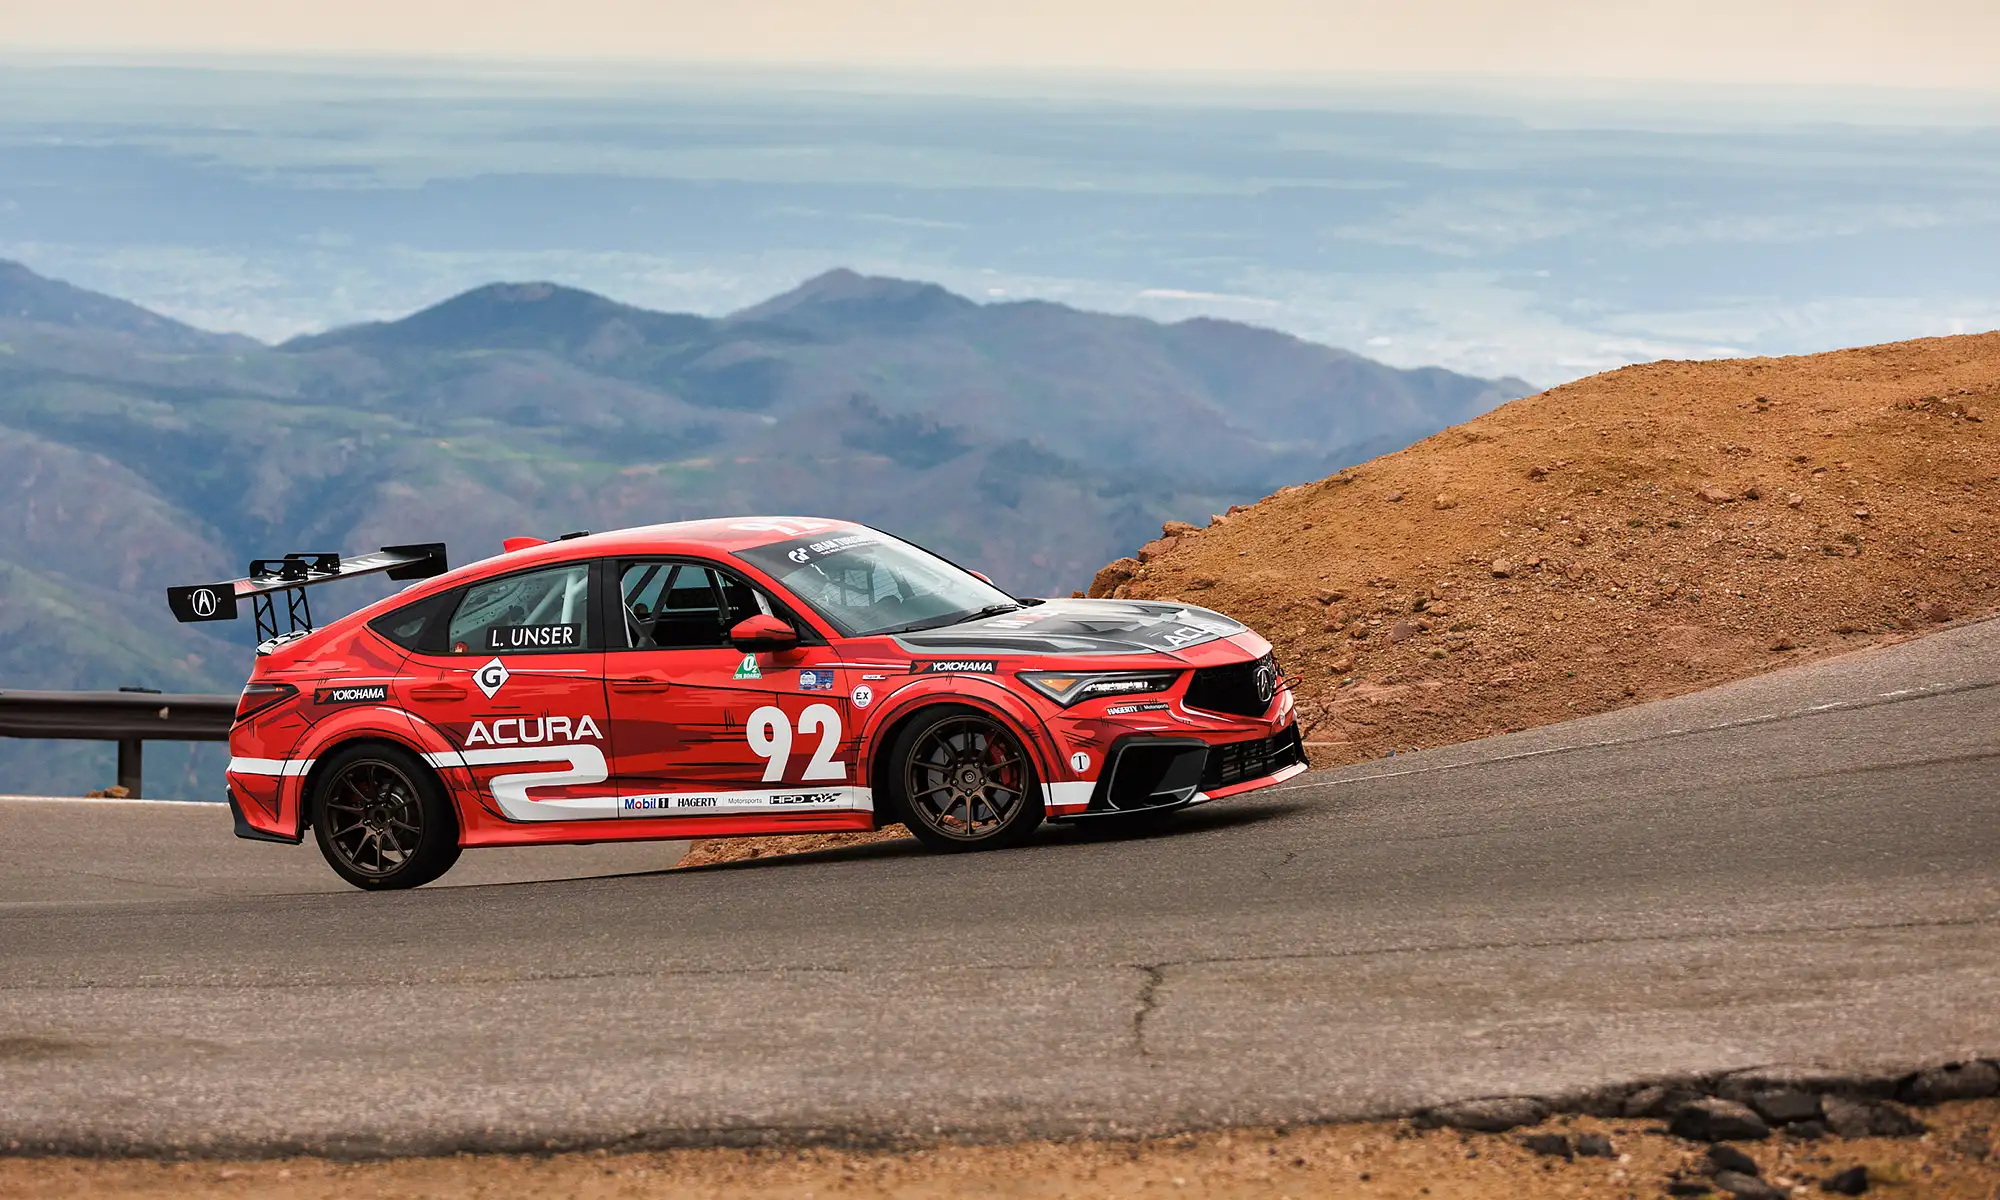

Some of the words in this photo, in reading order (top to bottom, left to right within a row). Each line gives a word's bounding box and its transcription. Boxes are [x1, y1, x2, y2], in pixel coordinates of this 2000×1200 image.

[809, 539, 837, 553] GRAN
[492, 629, 504, 647] L.
[511, 626, 573, 646] UNSER
[932, 661, 993, 672] YOKOHAMA
[481, 665, 503, 688] G
[332, 688, 385, 700] YOKOHAMA
[856, 691, 869, 700] EX
[1106, 705, 1138, 716] HAGERTY
[1143, 703, 1169, 711] Motorsports
[464, 714, 604, 746] ACURA
[746, 703, 847, 782] 92
[1072, 755, 1088, 770] T
[624, 798, 656, 809] Mobil
[658, 797, 670, 809] 1
[677, 797, 718, 807] HAGERTY
[728, 797, 763, 805] Motorsports
[769, 795, 805, 805] HPD
